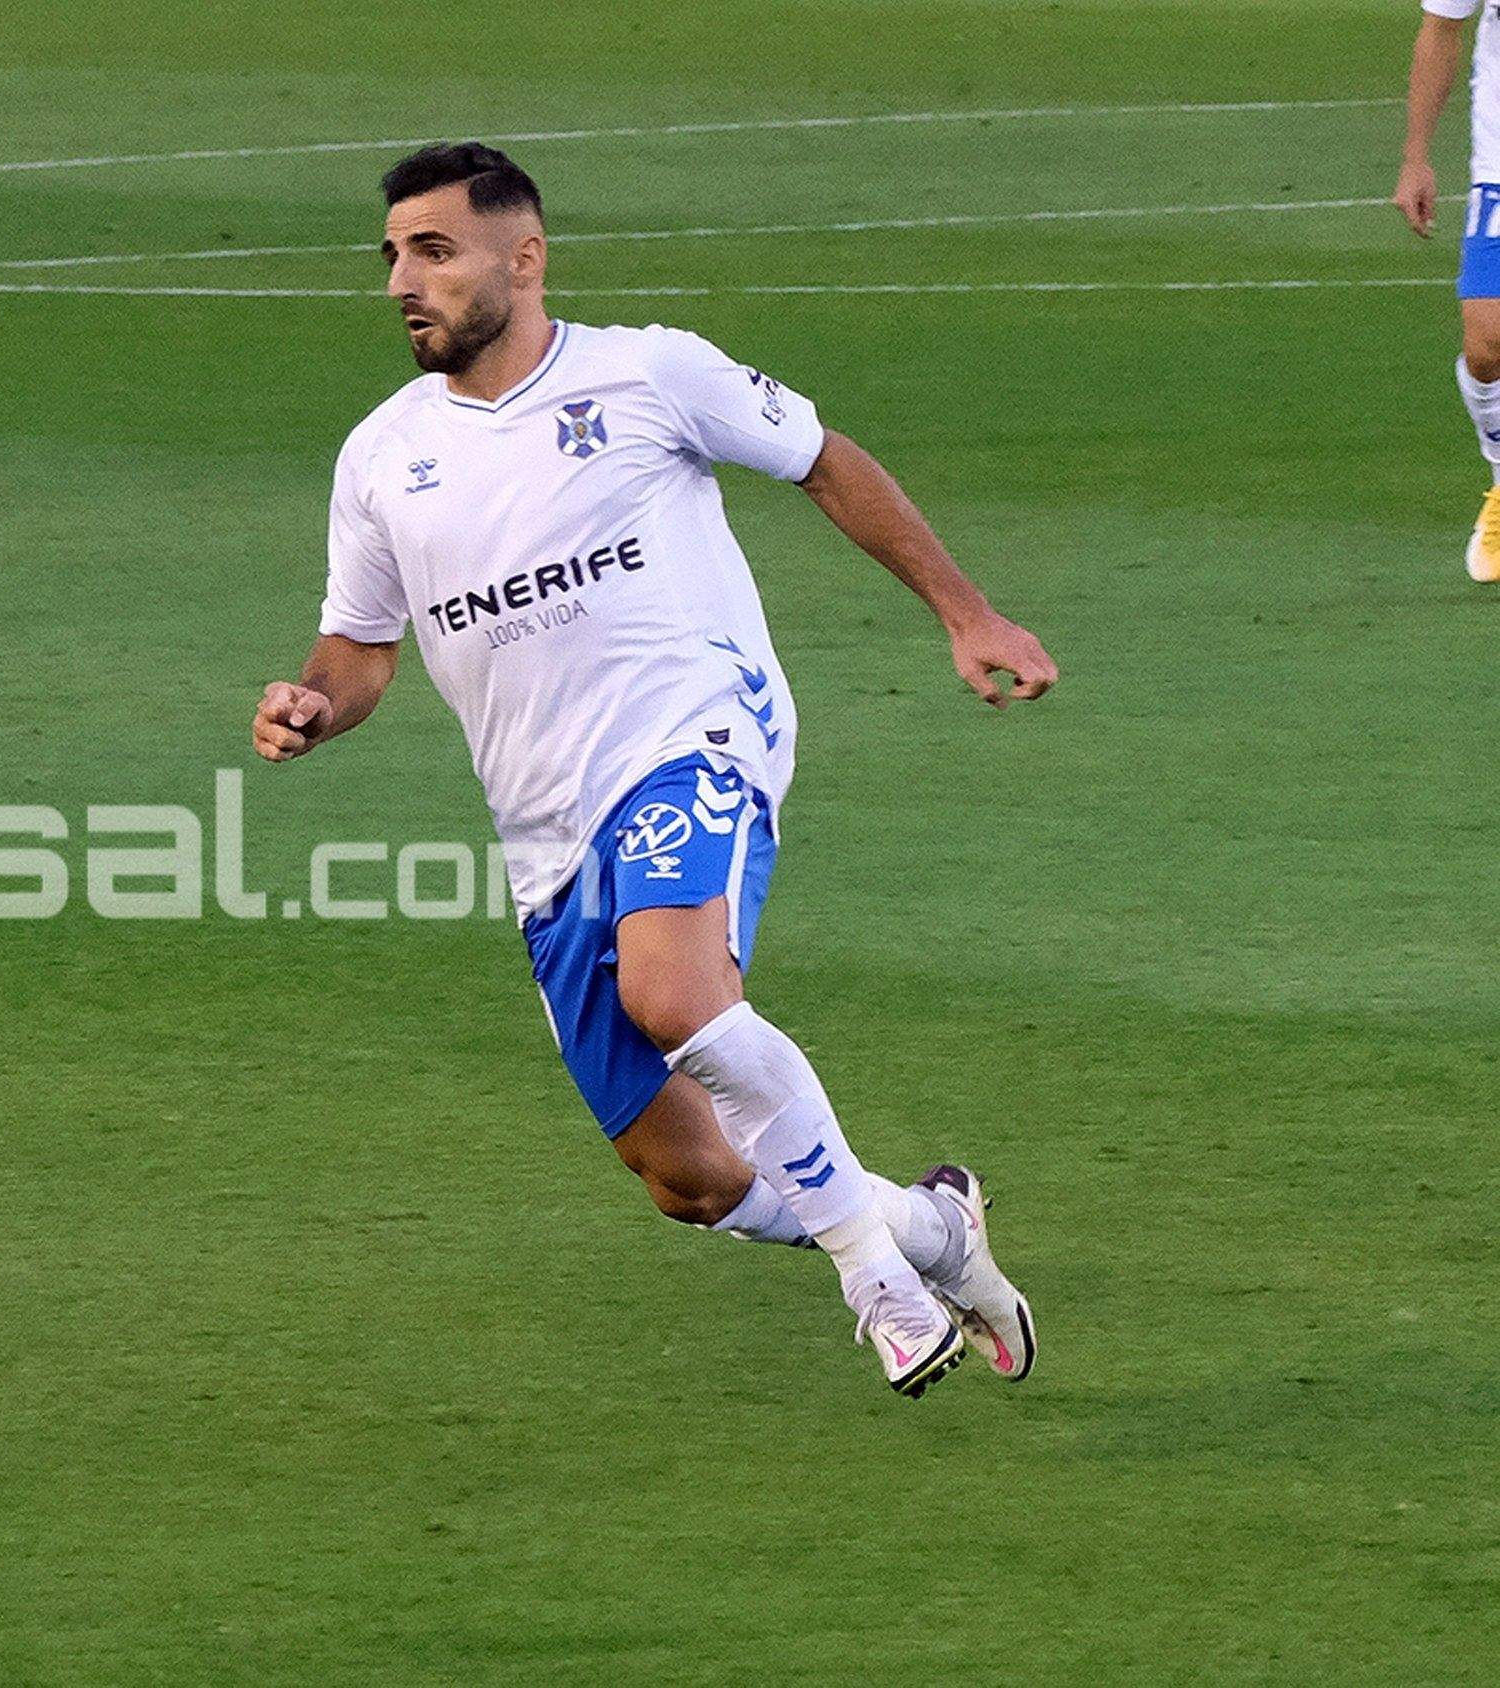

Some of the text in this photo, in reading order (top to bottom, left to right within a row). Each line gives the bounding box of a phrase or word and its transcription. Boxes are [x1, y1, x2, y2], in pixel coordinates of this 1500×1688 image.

[428, 537, 645, 636] TENERIFE
[484, 599, 589, 649] 100% VIDA
